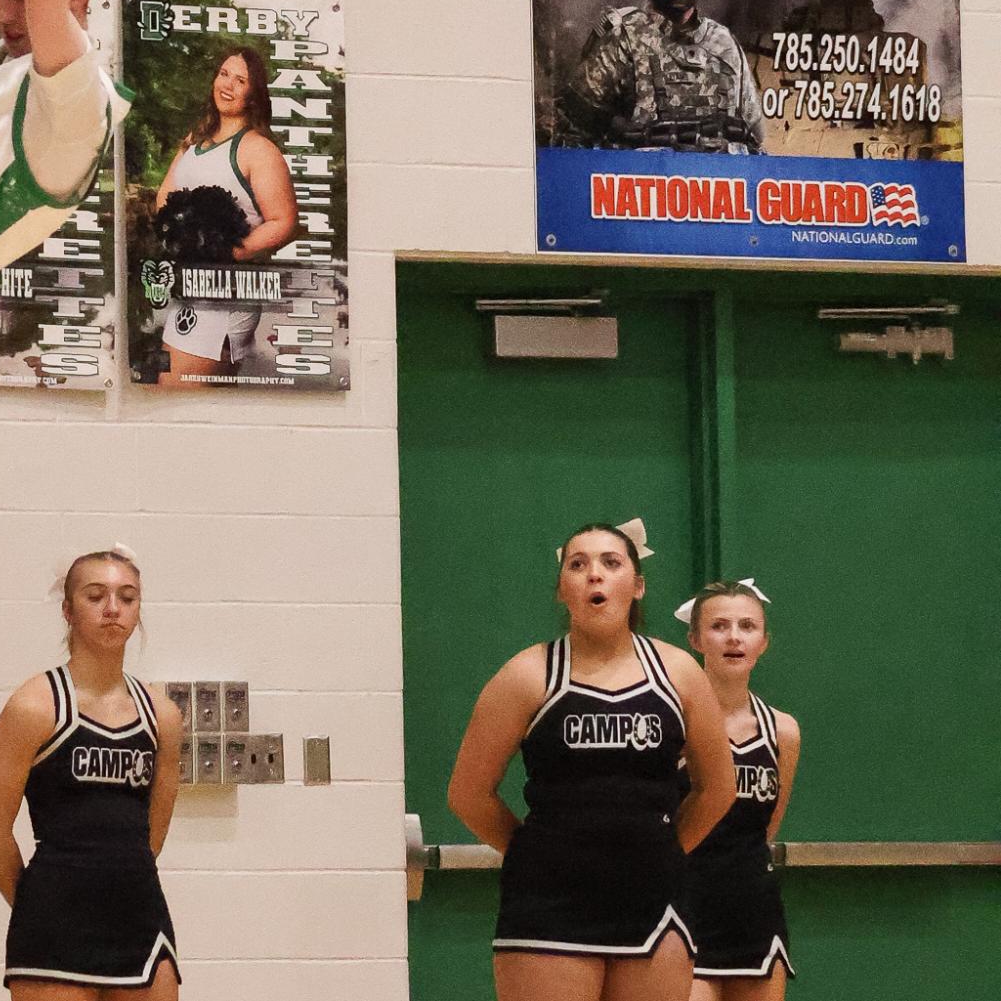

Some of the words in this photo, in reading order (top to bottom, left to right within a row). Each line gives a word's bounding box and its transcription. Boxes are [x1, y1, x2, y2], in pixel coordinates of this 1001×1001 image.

[137, 1, 319, 40] DERBY
[773, 32, 920, 75] 785.250.1484
[763, 88, 789, 118] or
[794, 80, 941, 122] 785.274.1618
[591, 173, 753, 223] NATIONAL
[757, 178, 872, 227] GUARD
[791, 231, 918, 246] NATIONALGUARD.com
[1, 268, 33, 298] HITE
[182, 268, 232, 298] ISABELLA
[235, 270, 282, 299] WALKER
[563, 713, 662, 751] CAMPUS
[734, 765, 779, 802] MPUS
